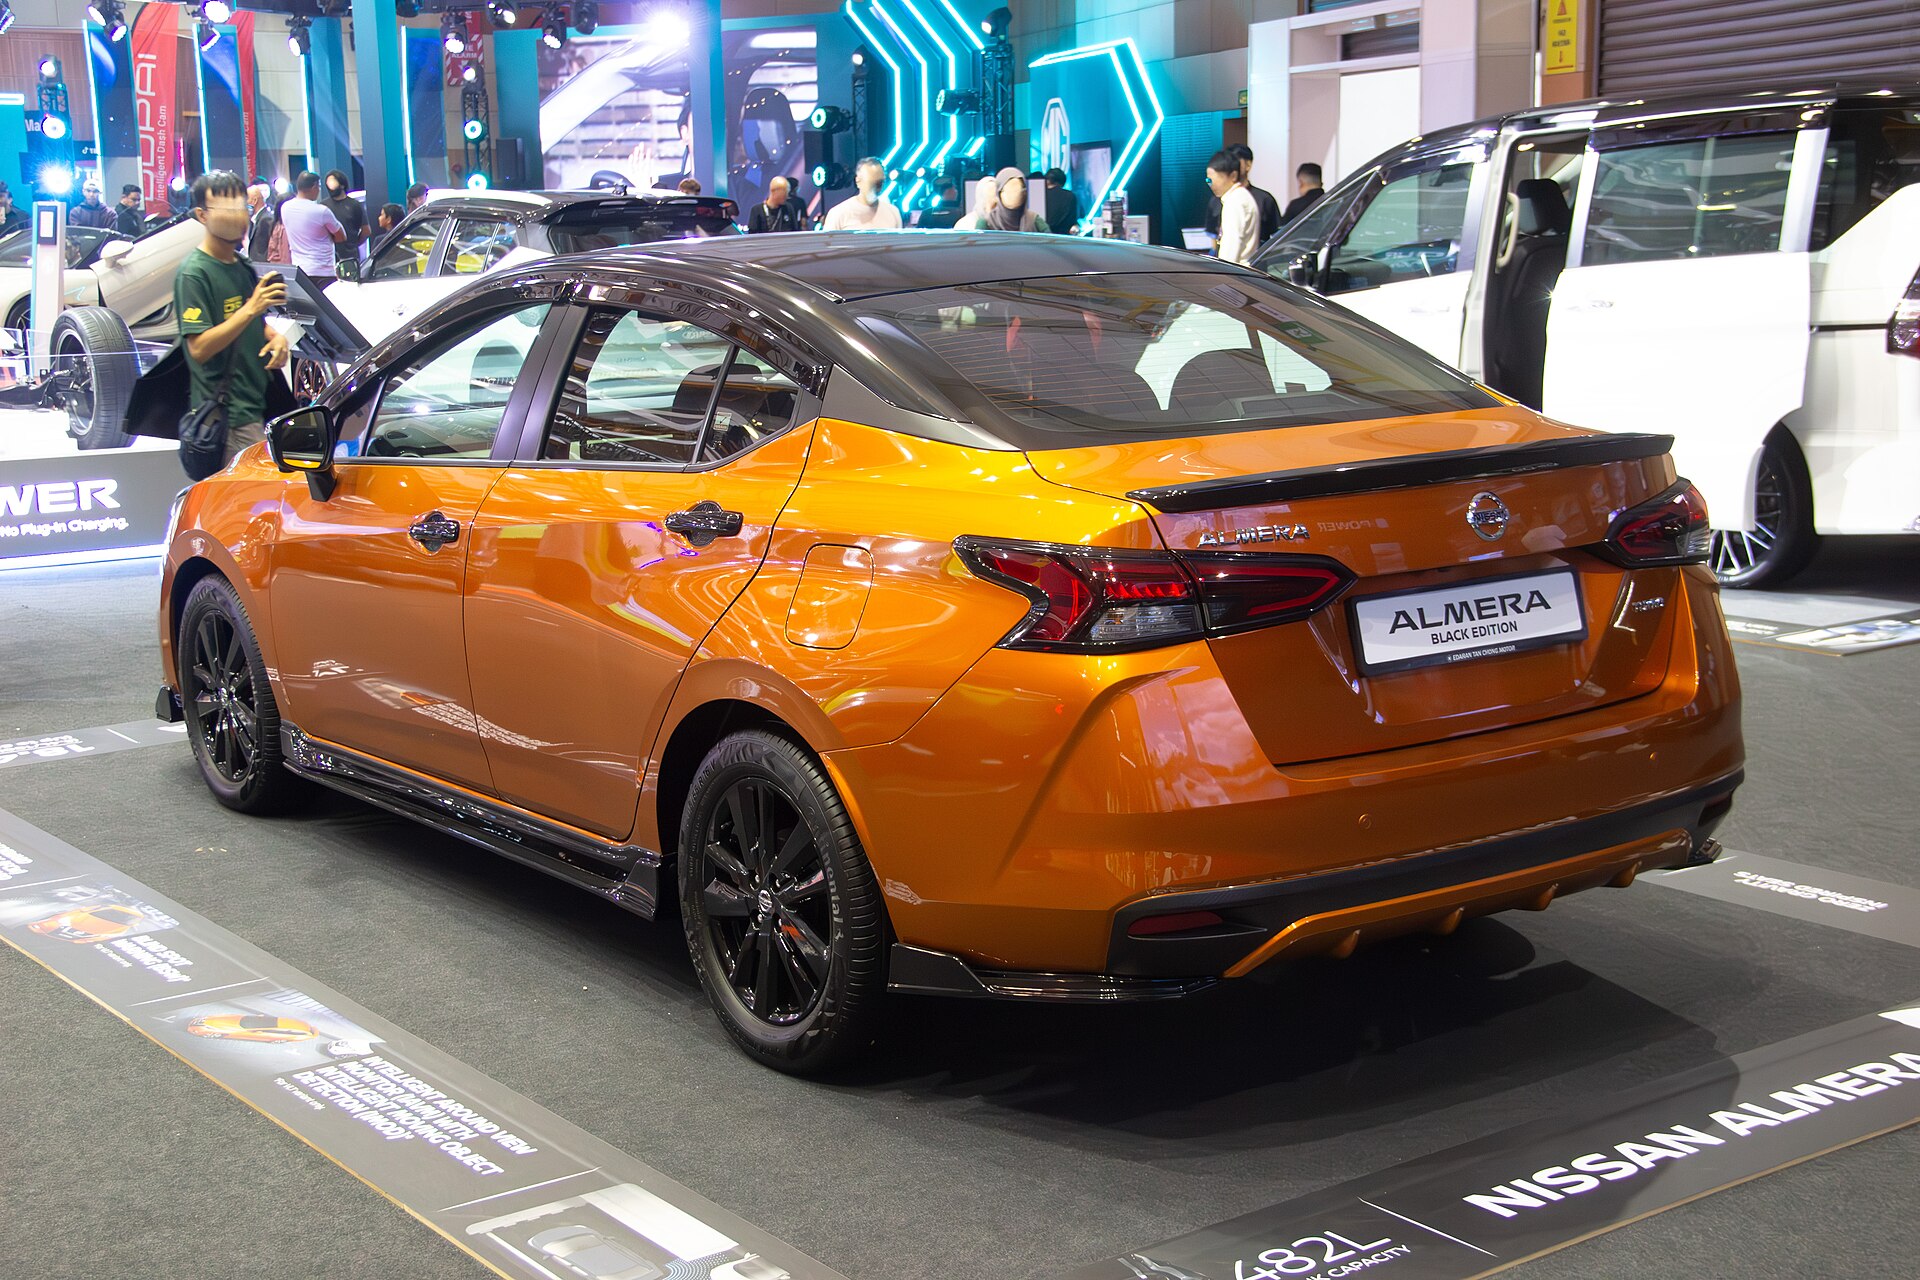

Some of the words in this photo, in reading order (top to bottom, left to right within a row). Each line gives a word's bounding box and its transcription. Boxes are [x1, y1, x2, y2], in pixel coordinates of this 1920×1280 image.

[158, 105, 167, 127] Cam
[157, 129, 167, 153] Dash
[155, 153, 167, 202] Intelligent
[19, 521, 67, 537] Plug-in
[1196, 523, 1310, 548] ALMERA
[1388, 589, 1552, 635] ALMERA
[1431, 627, 1470, 645] BLACK
[1472, 620, 1518, 639] EDITION
[1452, 651, 1472, 661] EDARAN
[1471, 649, 1482, 658] TAN
[1481, 647, 1499, 656] CHONG
[1498, 644, 1516, 654] MOTOR
[155, 950, 194, 967] SPOT
[292, 1070, 370, 1114] DETECTION
[338, 1061, 405, 1097] MONITOR
[391, 1092, 447, 1120] (IAVM)
[433, 1116, 480, 1140] WITH
[361, 1055, 448, 1100] INTELLIGENT
[433, 1098, 501, 1134] AROUND
[490, 1130, 538, 1155] VIEW
[315, 1066, 401, 1112] INTELLIGENT
[387, 1108, 452, 1144] MOVING
[439, 1141, 505, 1175] OBJECT
[1462, 1124, 1726, 1219] NISSAN
[1708, 1052, 1920, 1138] ALMERA
[1234, 1230, 1392, 1280] 482L
[1327, 1244, 1412, 1277] CAPACITY
